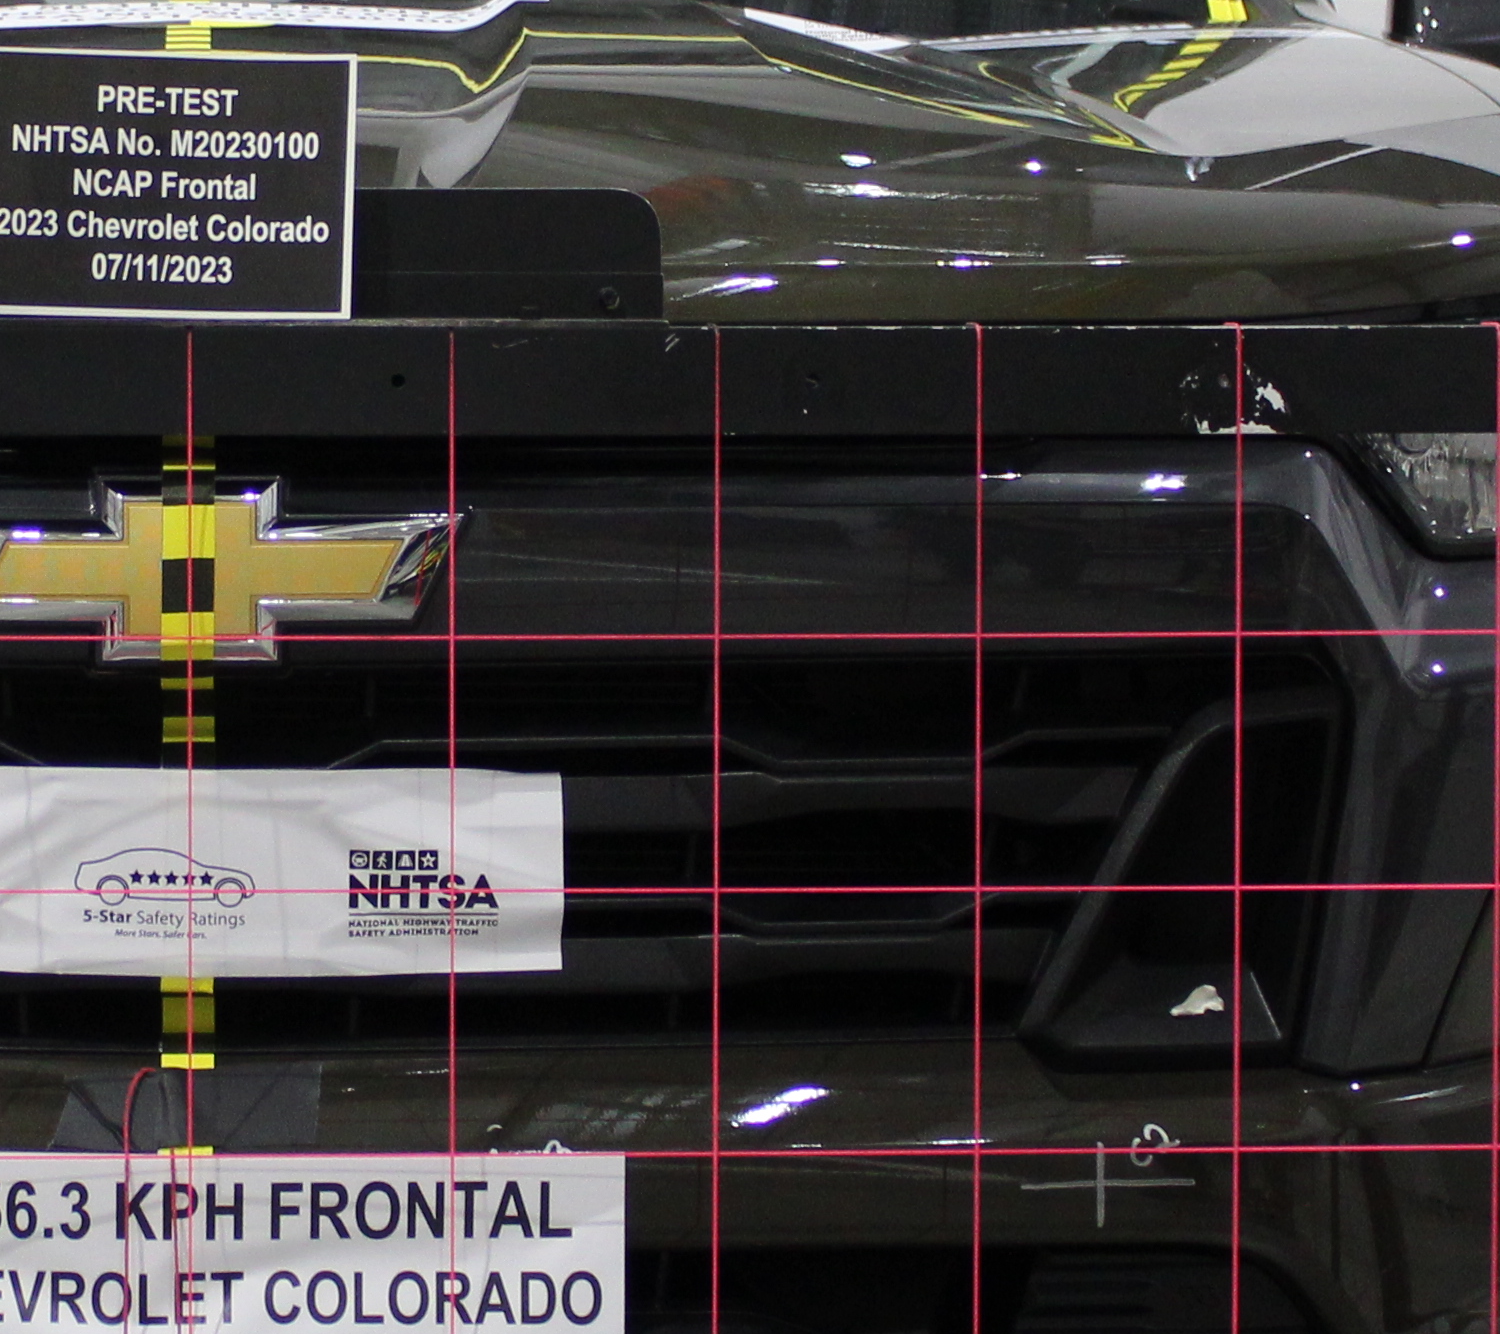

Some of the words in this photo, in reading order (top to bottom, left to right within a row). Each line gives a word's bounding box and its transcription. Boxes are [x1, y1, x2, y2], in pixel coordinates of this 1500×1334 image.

[97, 85, 239, 116] PRE-TEST
[11, 124, 110, 155] NHTSA
[117, 128, 162, 156] No.
[170, 131, 320, 160] M20230100
[73, 168, 154, 197] NCAP
[161, 171, 257, 201] Frontal
[66, 210, 199, 242] Chevrolet
[206, 214, 330, 243] Colorado
[91, 253, 233, 284] 07/11/2023
[348, 873, 499, 909] NHTSA
[83, 909, 132, 923] 5-Star
[136, 910, 185, 929] Safety
[114, 929, 136, 937] More
[348, 919, 399, 928] NATIONAL
[403, 919, 453, 927] HIGHWAY
[455, 919, 499, 927] TRAFFIC
[348, 928, 385, 937] SAFETY
[116, 1181, 245, 1241] KPH
[269, 1181, 573, 1240] FRONTAL
[264, 1269, 604, 1327] COLORADO
